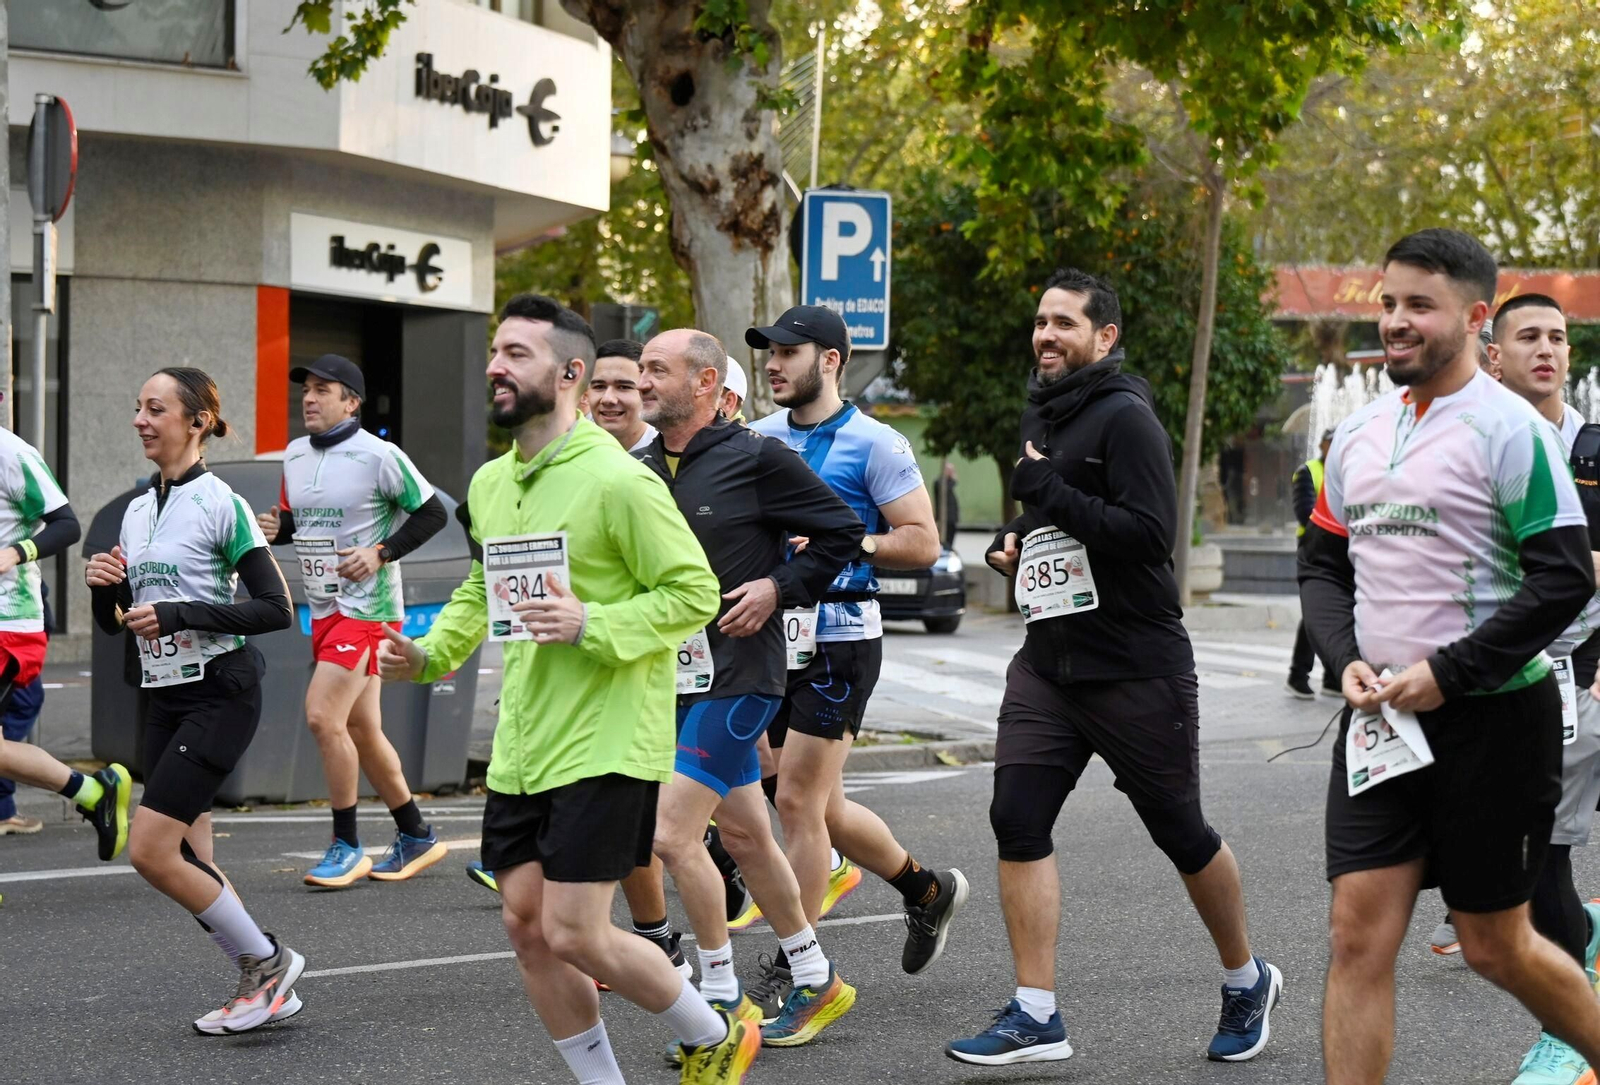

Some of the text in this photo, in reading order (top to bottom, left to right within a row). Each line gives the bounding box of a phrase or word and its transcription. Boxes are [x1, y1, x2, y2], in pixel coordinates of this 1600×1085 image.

[821, 201, 873, 281] P
[845, 298, 856, 313] de
[302, 507, 344, 518] SUBIDA
[1370, 503, 1439, 523] SUBIDA
[1376, 524, 1440, 537] ERMITAS
[139, 561, 179, 577] SUBIDA
[1026, 557, 1069, 592] 385
[507, 573, 547, 606] 384
[789, 939, 817, 957] FILA
[710, 958, 732, 969] FIL
